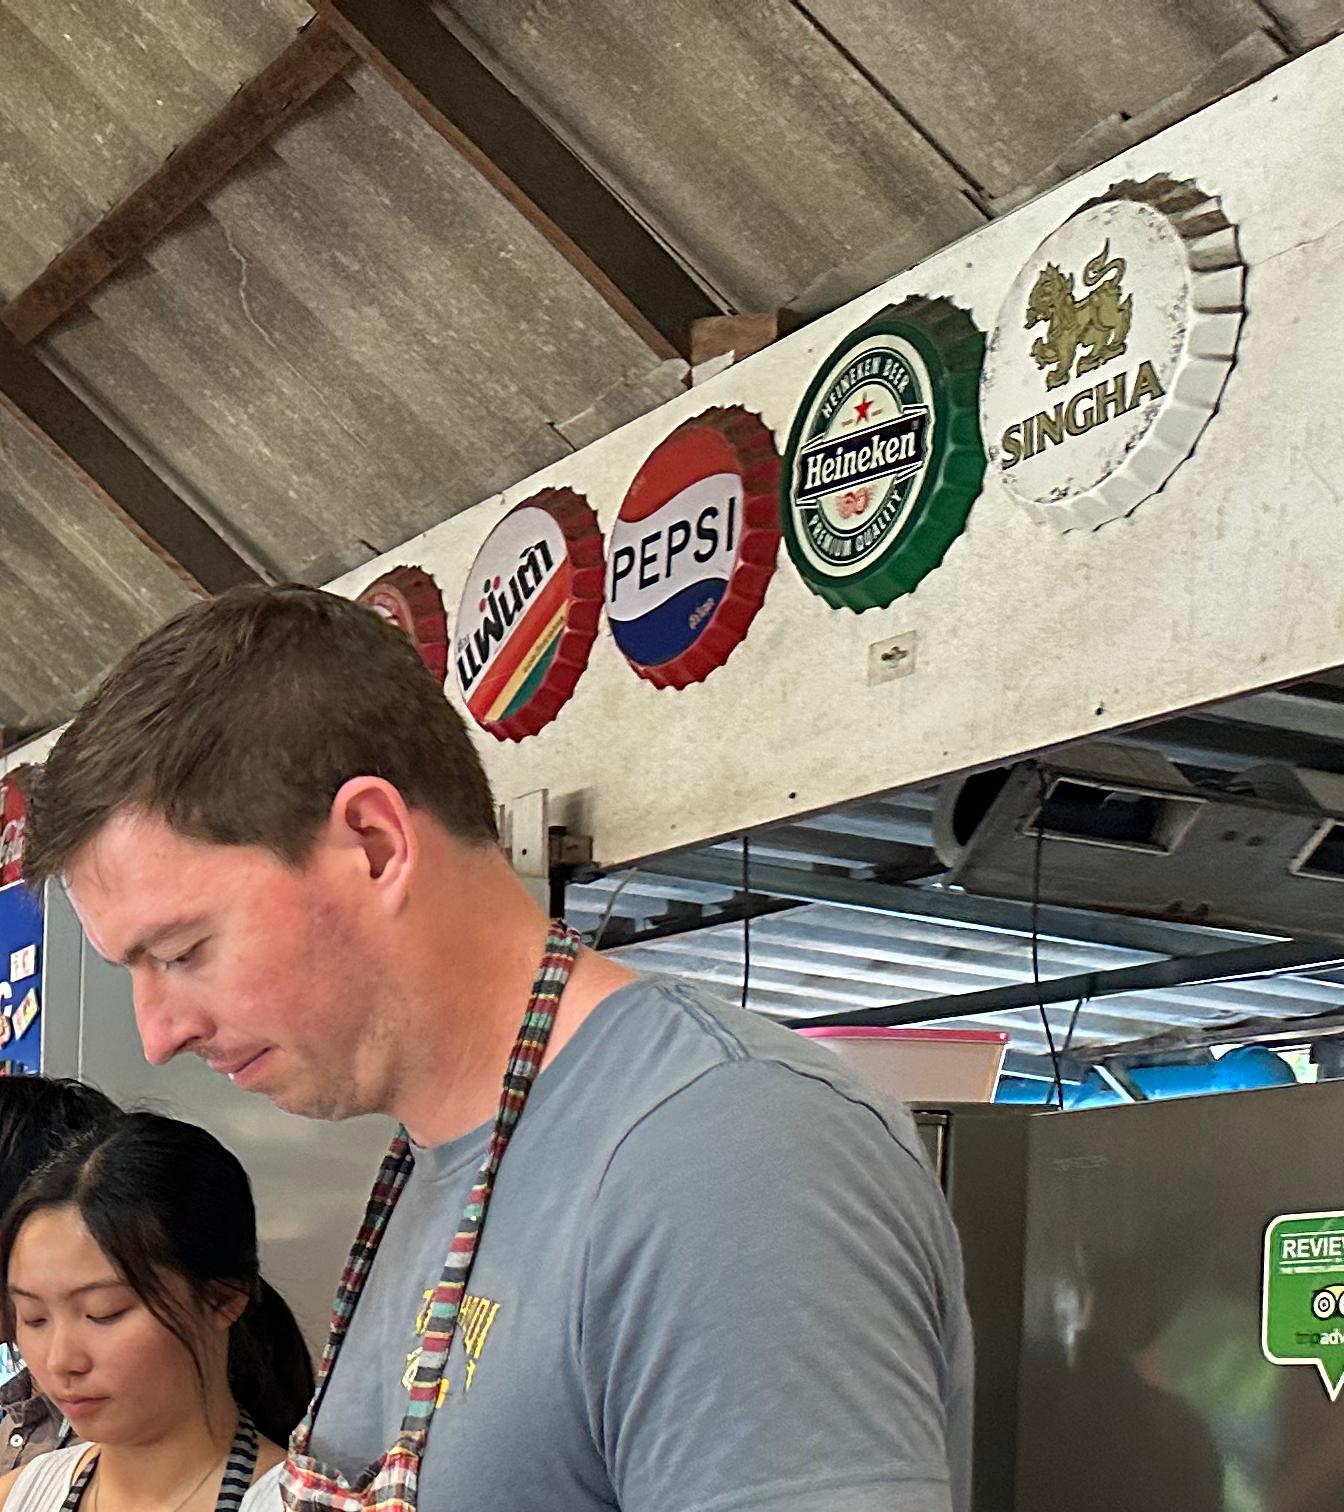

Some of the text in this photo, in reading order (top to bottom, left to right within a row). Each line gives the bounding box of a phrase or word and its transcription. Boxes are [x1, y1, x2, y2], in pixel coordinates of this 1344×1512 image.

[821, 356, 911, 419] HEINEKEN BEER
[1001, 360, 1167, 471] SINGHA
[803, 430, 916, 491] Heineken
[611, 496, 736, 603] PEPSI
[854, 488, 902, 552] QUALITY
[1281, 1237, 1344, 1259] REVIE
